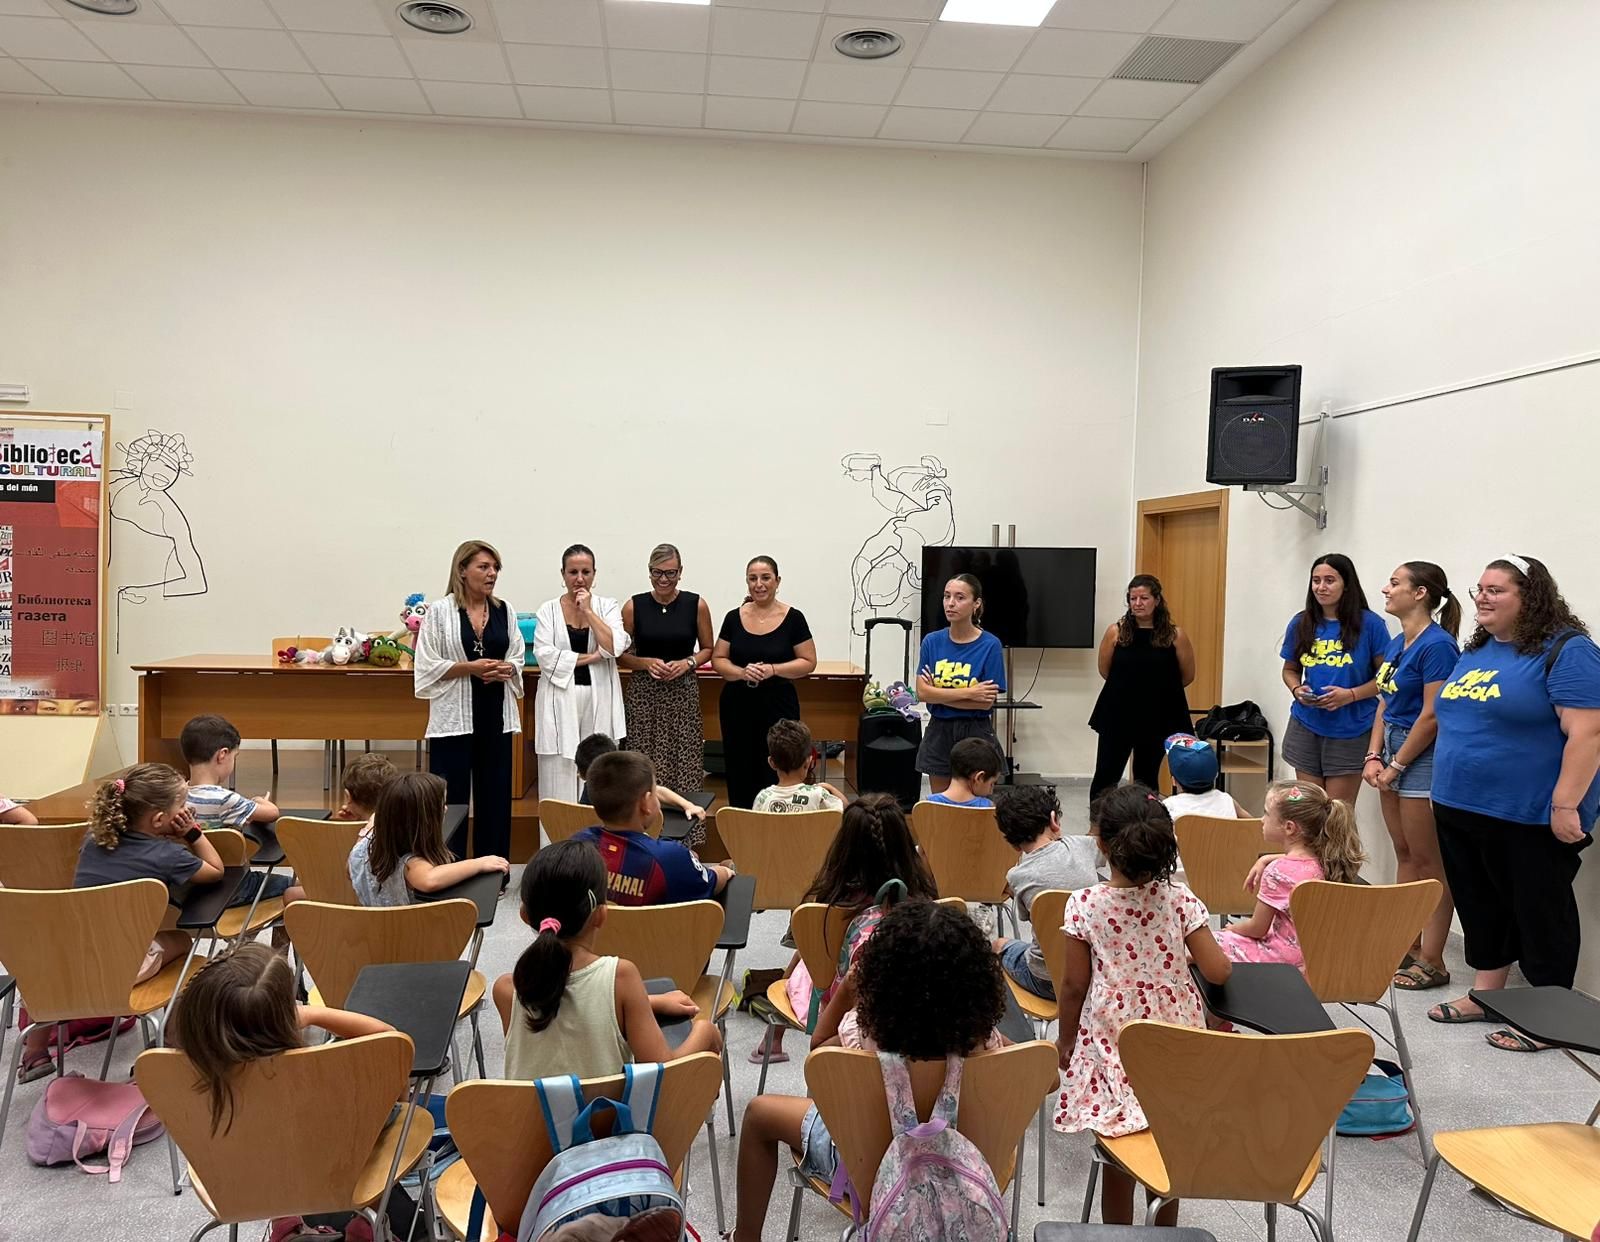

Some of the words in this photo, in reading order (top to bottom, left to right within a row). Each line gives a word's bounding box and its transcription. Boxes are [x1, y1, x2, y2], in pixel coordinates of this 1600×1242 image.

[0, 464, 96, 477] CULTURAL
[6, 483, 19, 491] del
[21, 484, 38, 492] món
[17, 593, 92, 606] Библиотека
[17, 611, 67, 622] газета
[1300, 652, 1354, 668] ESCOLA
[935, 658, 972, 678] FEM
[1440, 681, 1501, 702] ESCOLA
[607, 871, 645, 897] YAMAL
